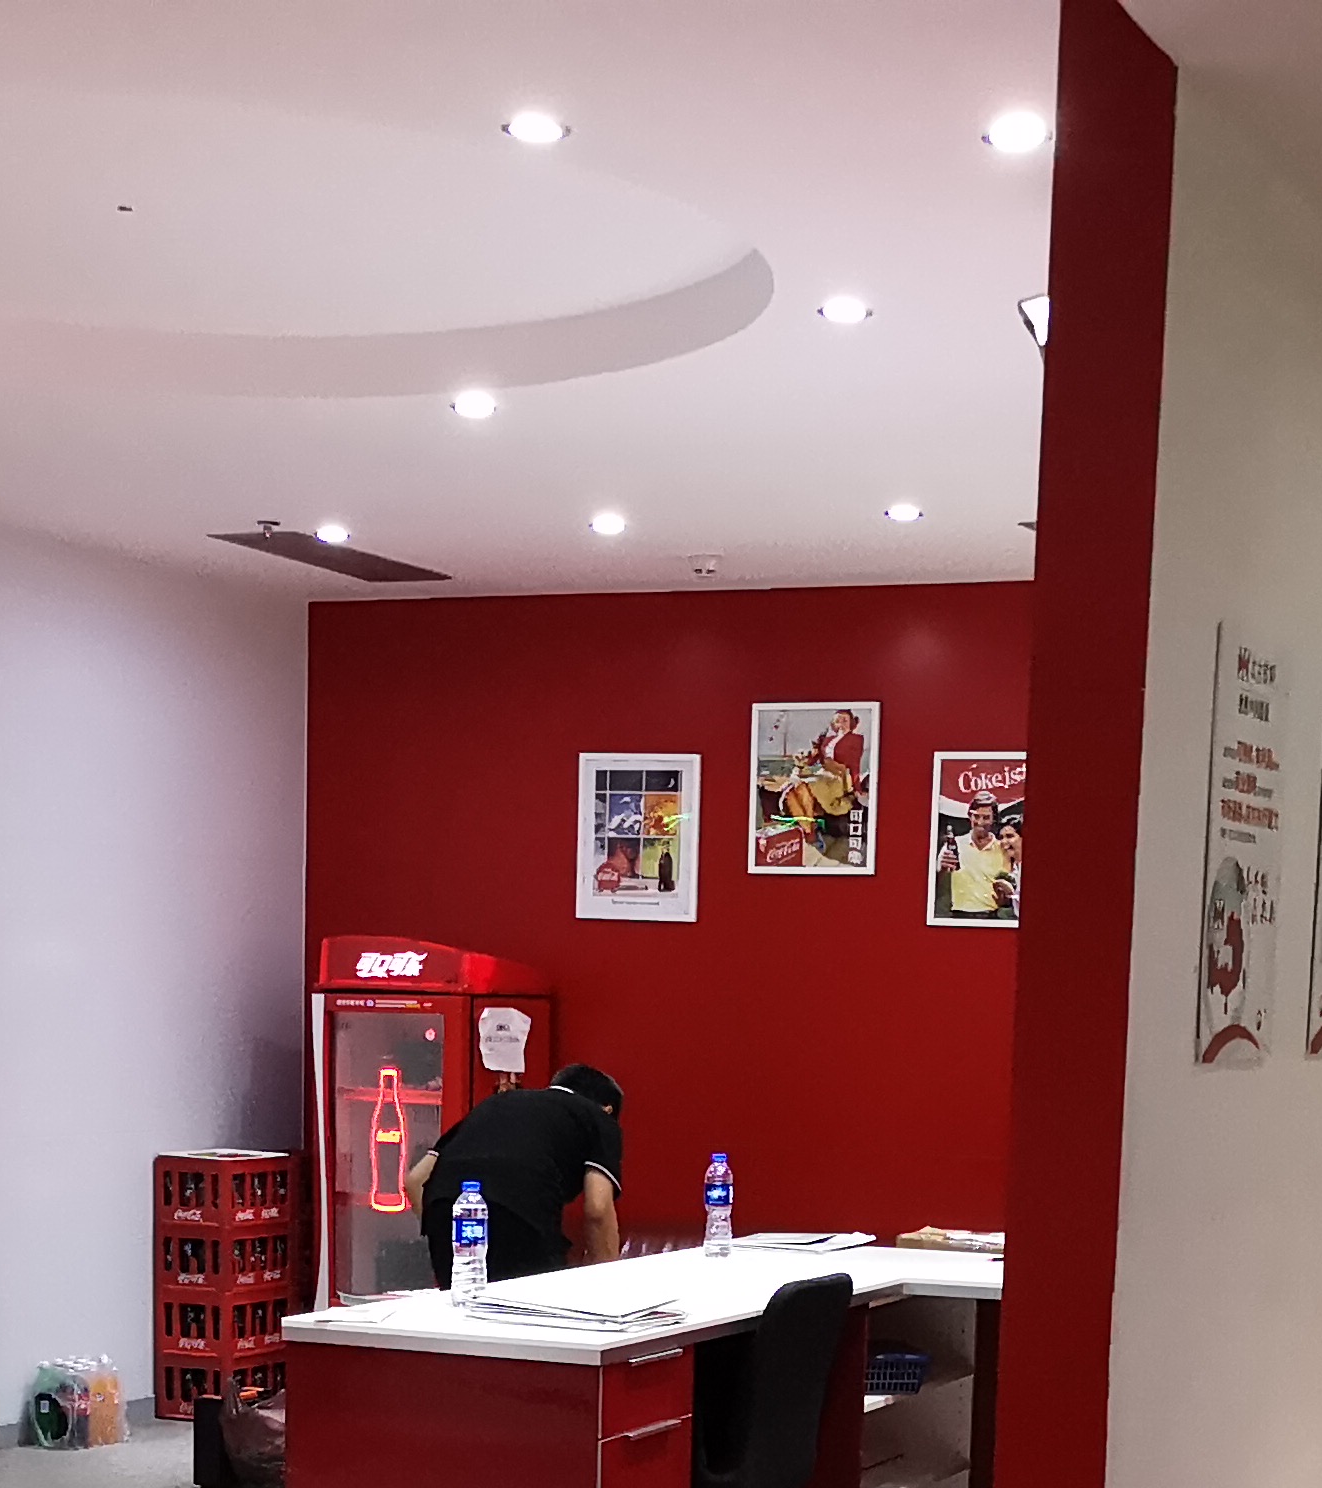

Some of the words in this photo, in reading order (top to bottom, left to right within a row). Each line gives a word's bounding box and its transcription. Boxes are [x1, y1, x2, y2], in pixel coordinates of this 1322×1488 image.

[958, 771, 1003, 793] Coke
[356, 951, 428, 978] 可口可乐
